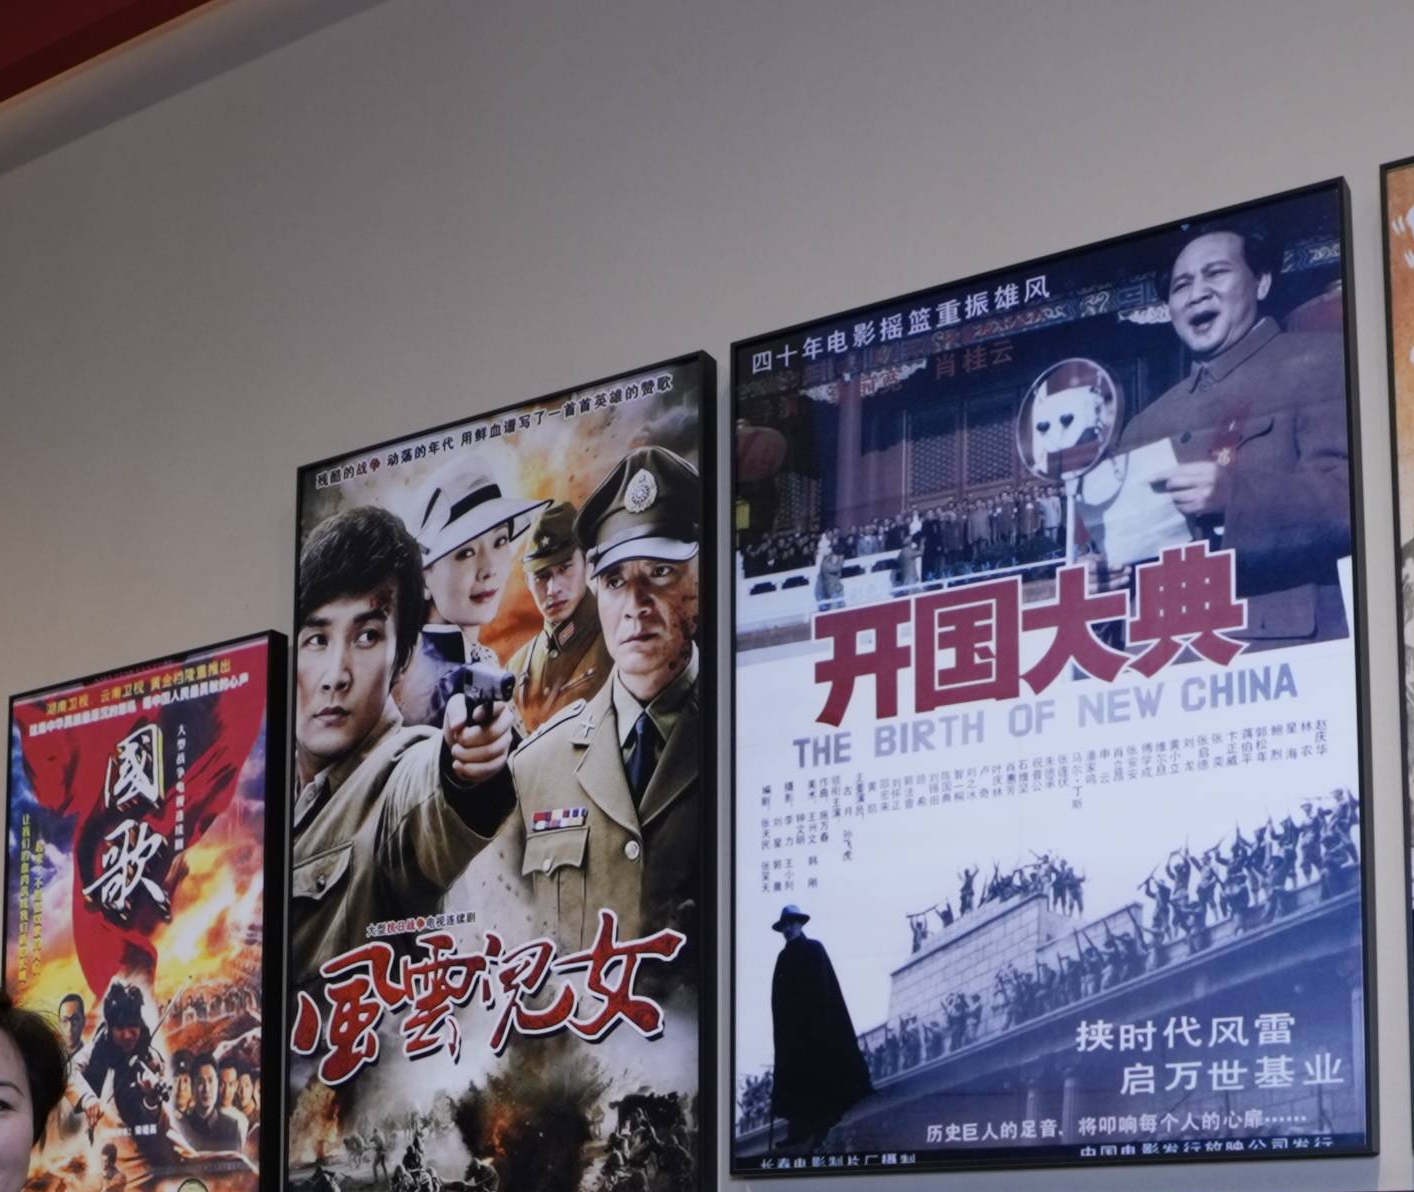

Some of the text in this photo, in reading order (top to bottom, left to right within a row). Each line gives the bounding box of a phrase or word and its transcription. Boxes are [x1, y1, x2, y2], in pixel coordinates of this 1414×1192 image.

[752, 274, 1050, 375] 四十年电影摇篮重振雄风
[936, 339, 1014, 379] 肖桂云
[812, 540, 1252, 728] 开国大典
[793, 663, 1300, 769] THE BIRTH OF NEW CHINA
[1076, 1012, 1296, 1052] 挟时代风雷
[1120, 1052, 1345, 1095] 启万世基业
